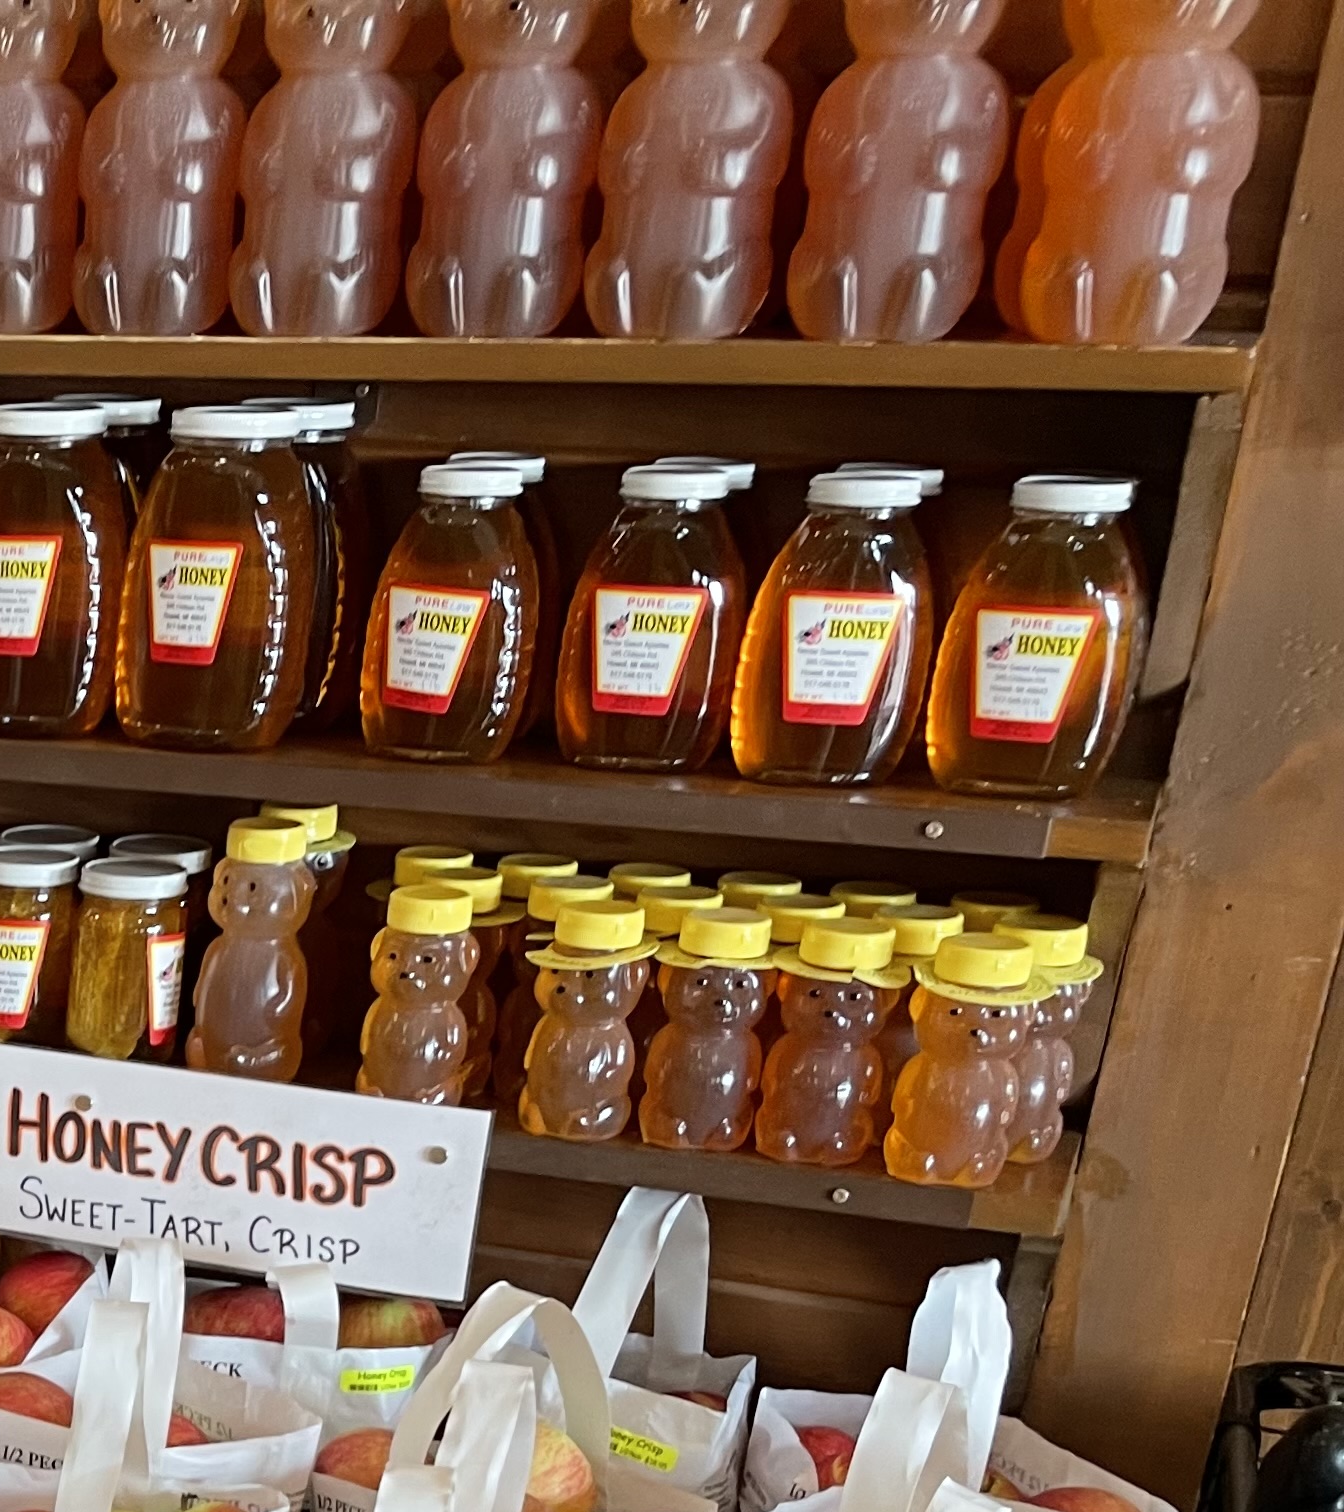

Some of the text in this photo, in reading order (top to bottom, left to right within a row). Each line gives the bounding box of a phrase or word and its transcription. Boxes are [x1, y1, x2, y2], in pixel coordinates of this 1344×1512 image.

[173, 551, 204, 563] PURE
[0, 560, 47, 579] HONEY
[179, 566, 228, 586] HONEY
[415, 595, 449, 609] PURE
[627, 596, 664, 610] PURE
[824, 602, 863, 615] PURE
[419, 611, 472, 635] HONEY
[632, 612, 690, 635] HONEY
[829, 619, 890, 640] HONEY
[1011, 617, 1053, 631] PURE
[1016, 634, 1081, 657] HONEY
[18, 1175, 361, 1266] SWEET-TART, CRISP
[358, 1371, 387, 1382] Honey
[637, 1438, 664, 1457] Crisp
[2, 1445, 64, 1471] 1/2 PEC
[316, 1494, 333, 1512] 1/2
